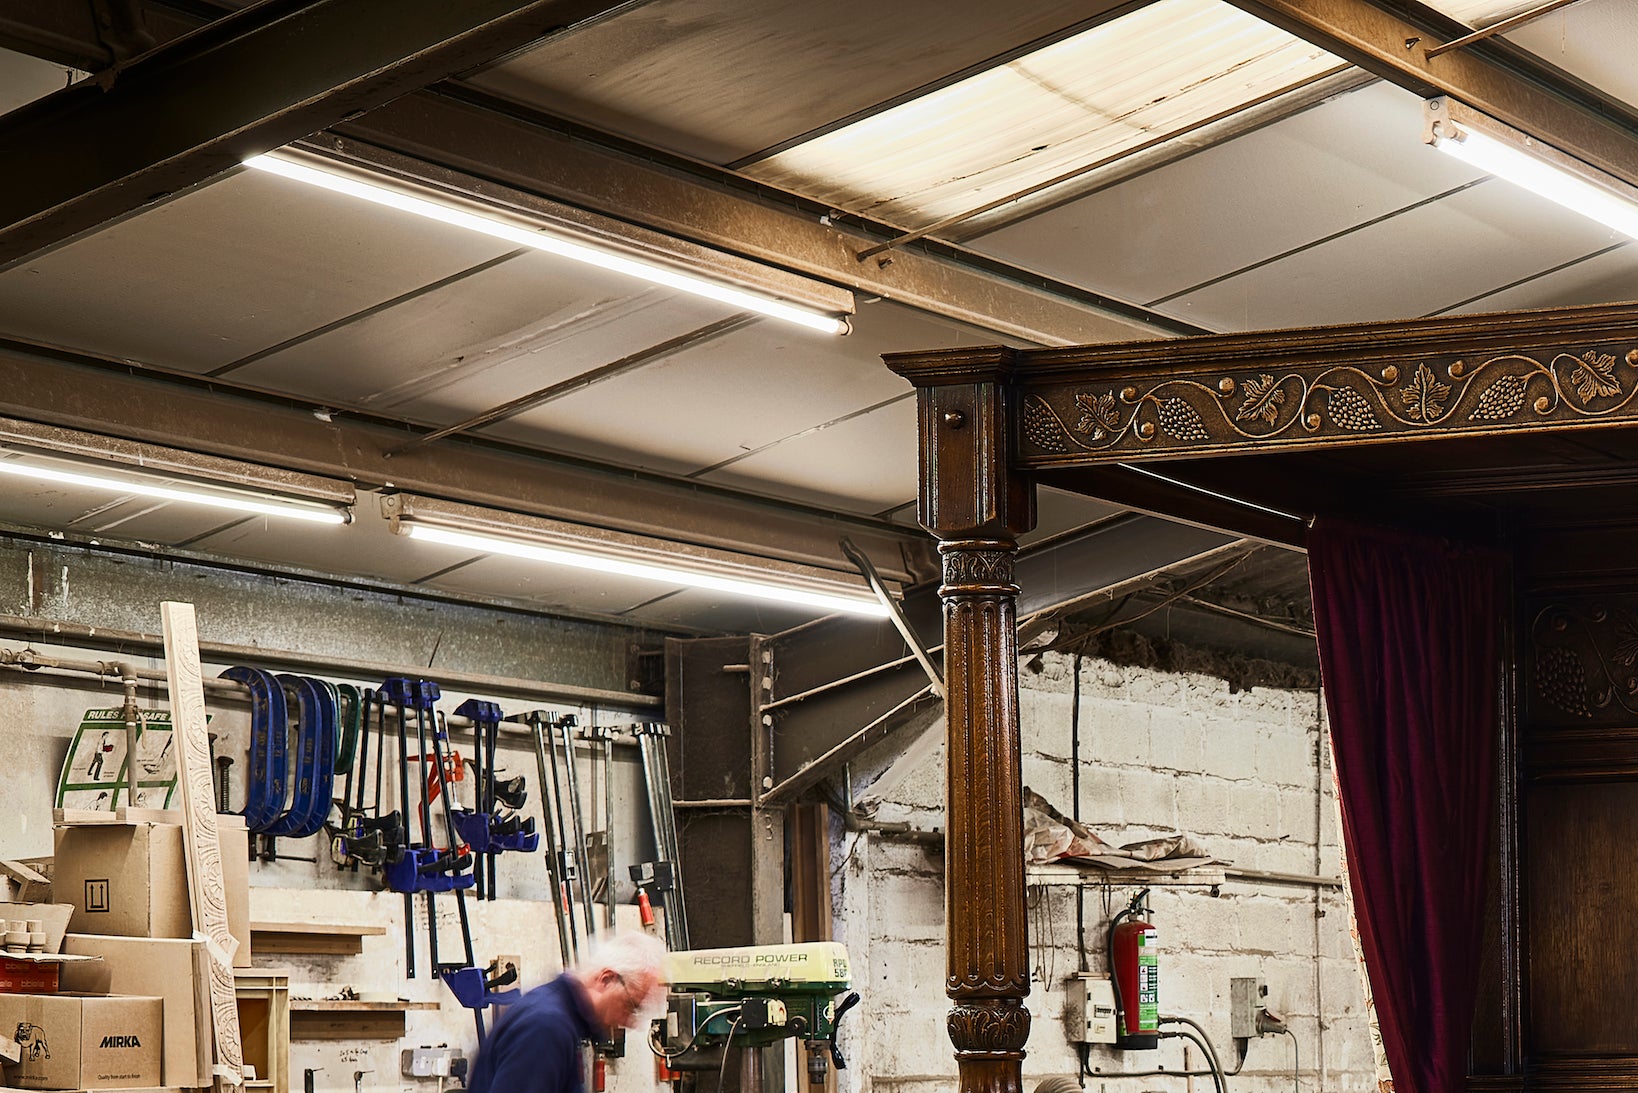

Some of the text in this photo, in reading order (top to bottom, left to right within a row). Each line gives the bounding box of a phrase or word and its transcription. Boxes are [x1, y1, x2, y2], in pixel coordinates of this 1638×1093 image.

[87, 710, 122, 720] RULES
[693, 953, 808, 965] RECORD POWER
[99, 1035, 141, 1049] MIRKA
